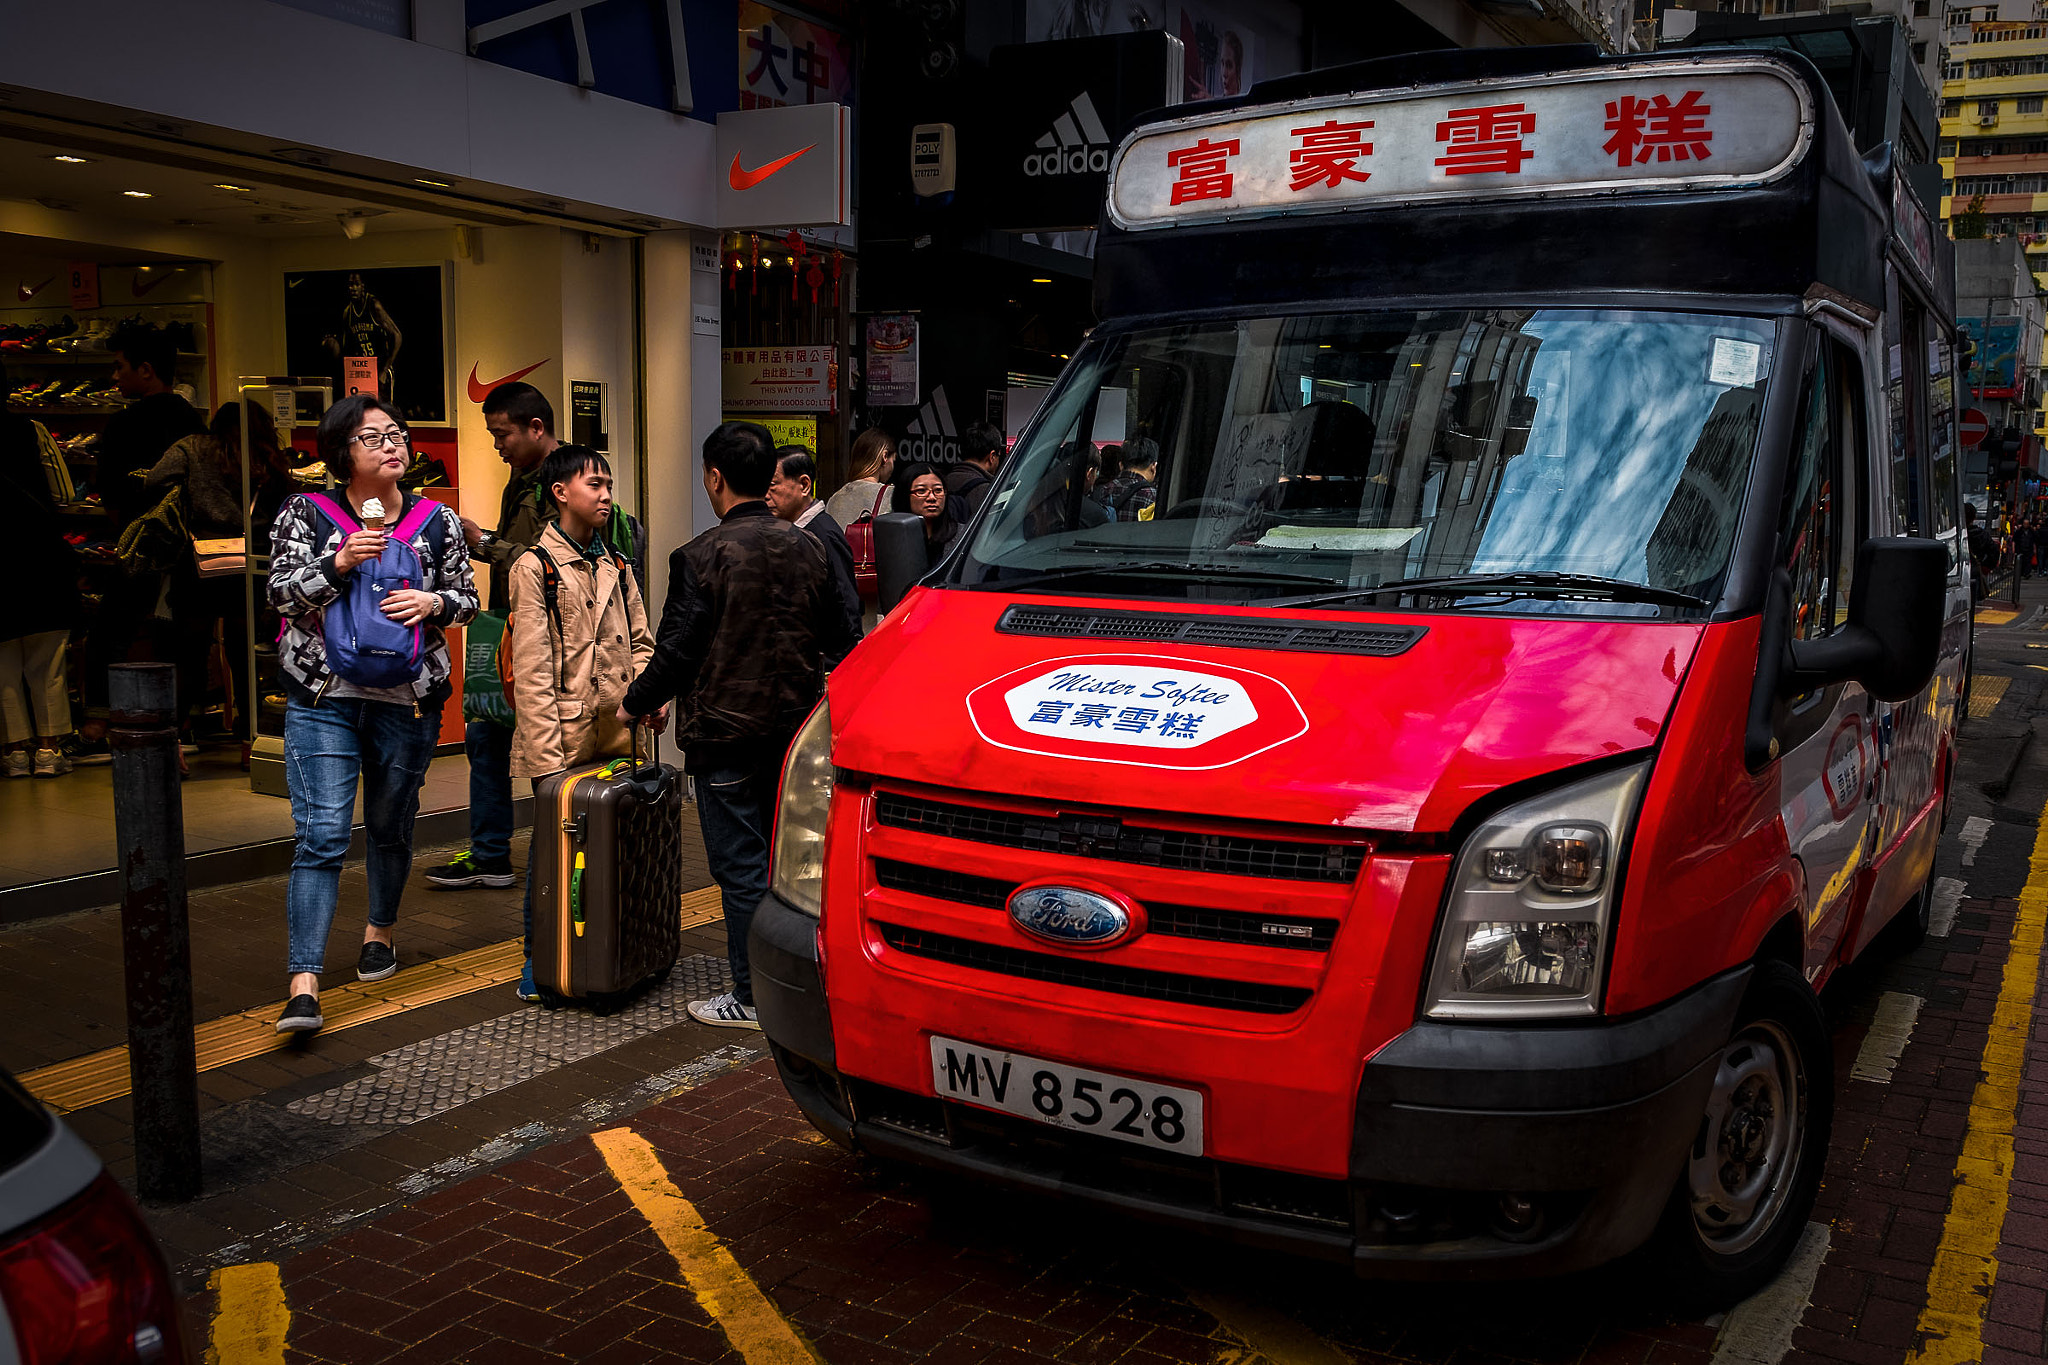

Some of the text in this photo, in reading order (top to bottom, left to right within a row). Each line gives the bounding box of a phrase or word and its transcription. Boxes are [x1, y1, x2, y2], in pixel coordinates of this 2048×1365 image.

[915, 143, 940, 154] POLY
[1023, 144, 1109, 177] adida
[1167, 90, 1713, 206] 富豪雪糕
[352, 360, 368, 368] NIKE
[745, 399, 779, 407] SPORTING
[780, 399, 804, 407] GOODS
[761, 386, 776, 394] THIS
[777, 386, 793, 394] WAY
[795, 386, 804, 394] TO
[1048, 672, 1230, 707] Mister Softee
[1028, 700, 1206, 740] 富豪雪糕
[1032, 896, 1098, 933] Ford
[945, 1048, 1186, 1144] MV 8528
